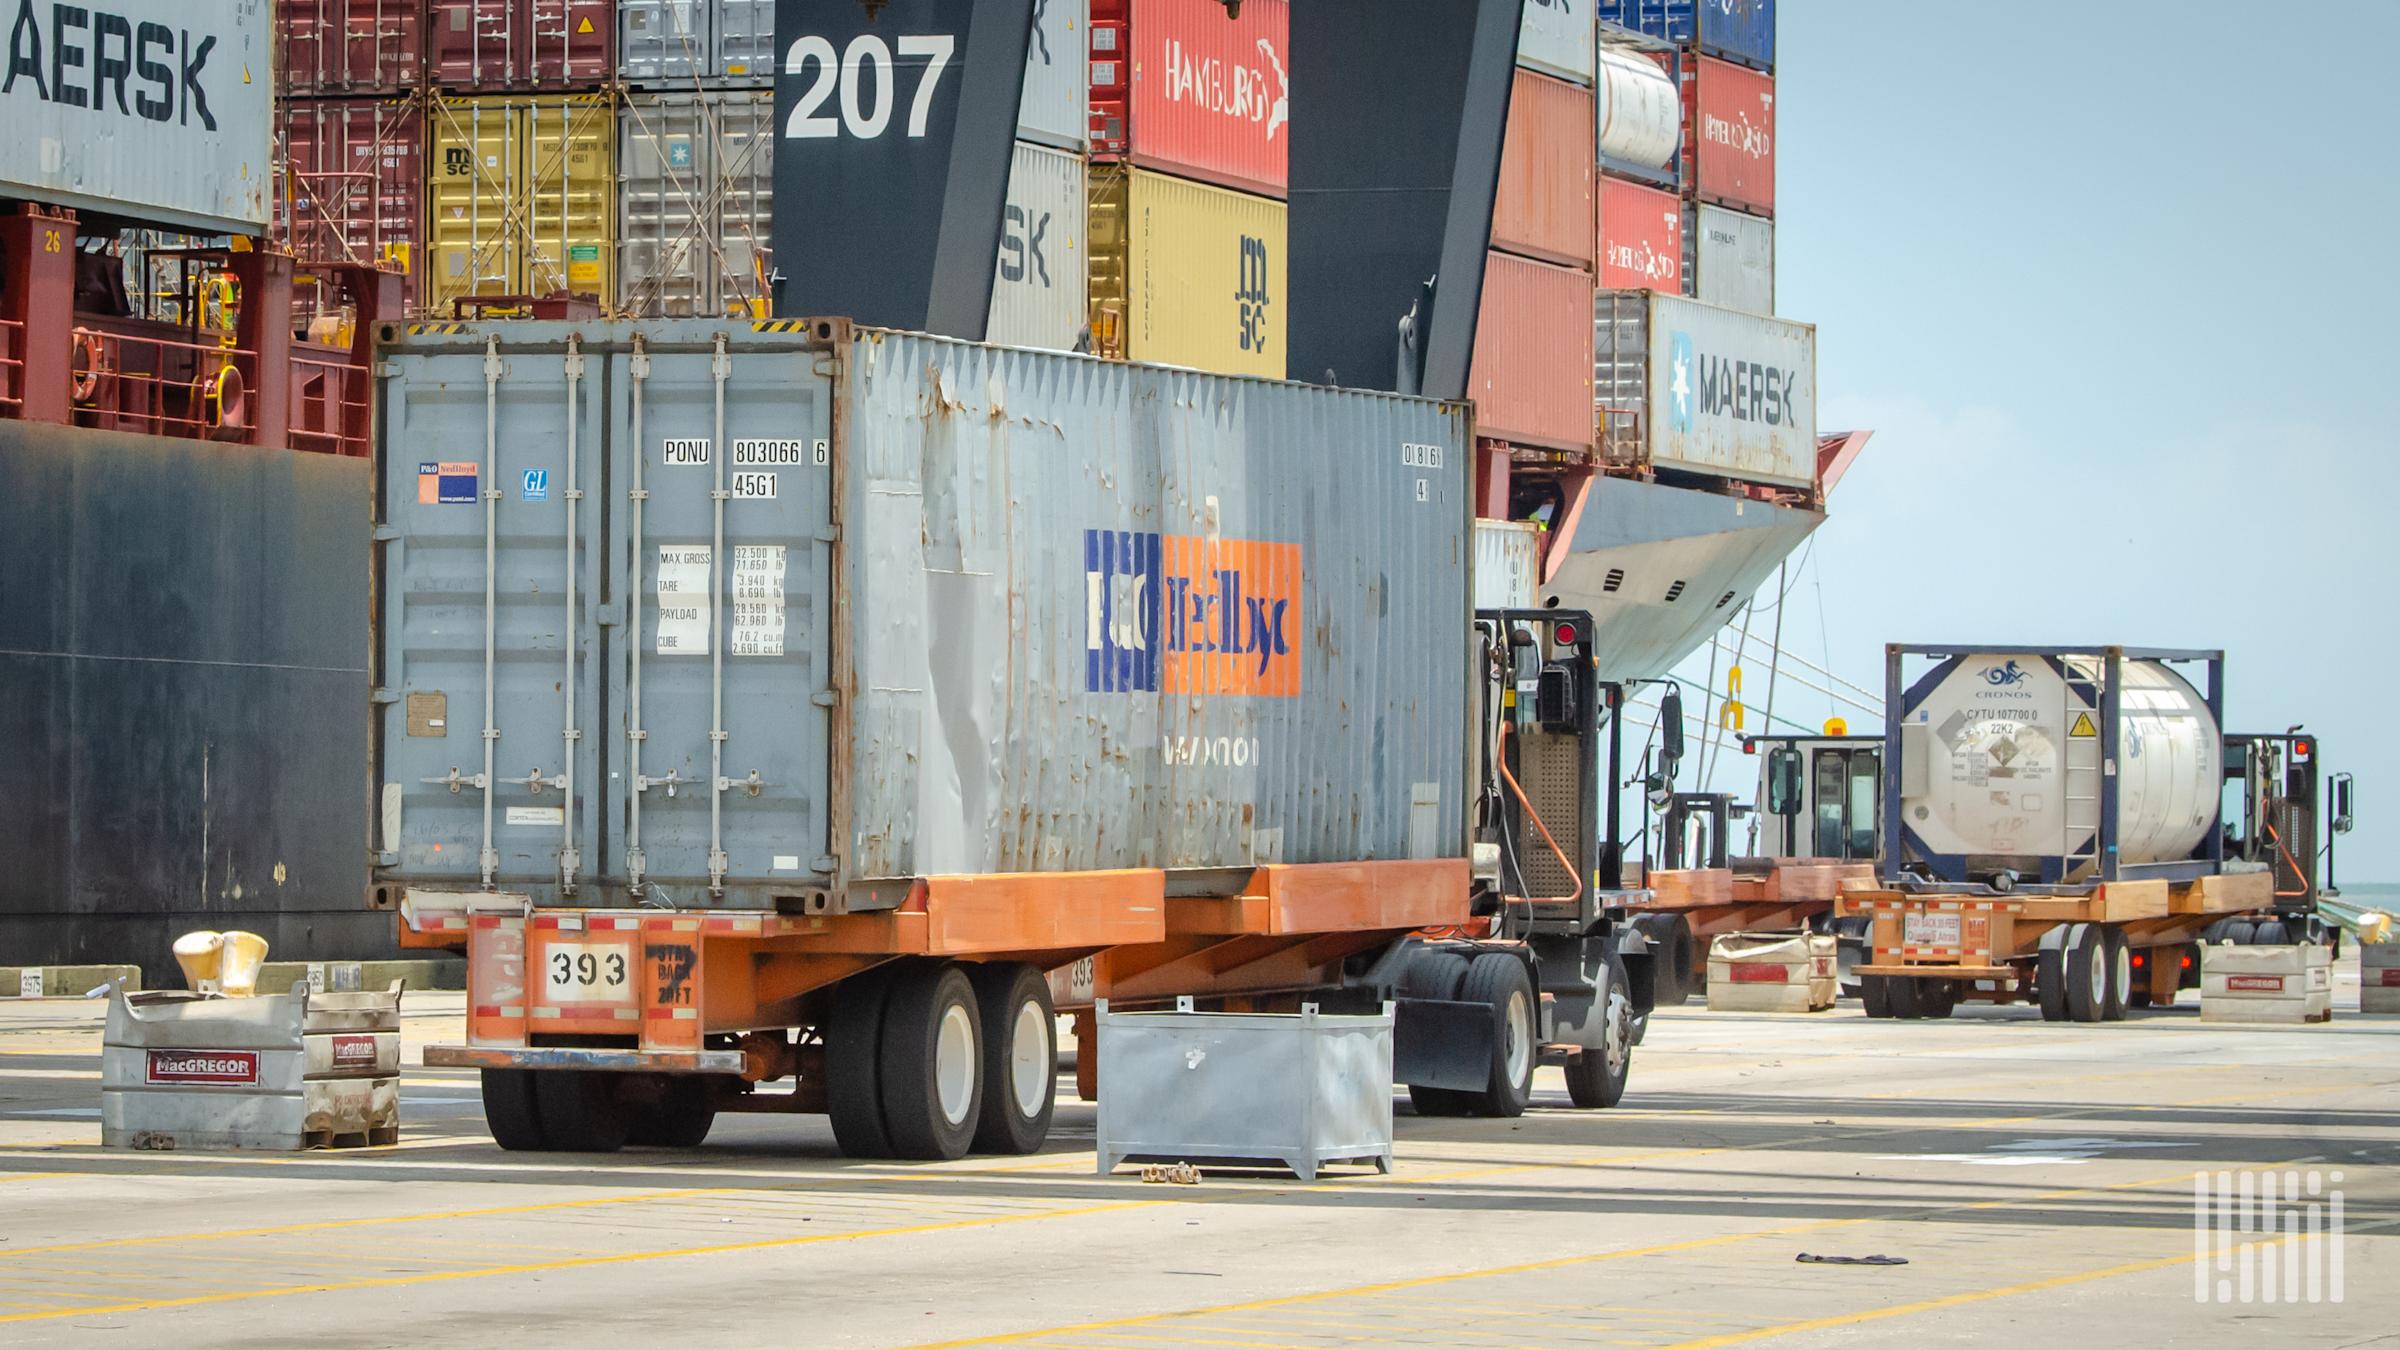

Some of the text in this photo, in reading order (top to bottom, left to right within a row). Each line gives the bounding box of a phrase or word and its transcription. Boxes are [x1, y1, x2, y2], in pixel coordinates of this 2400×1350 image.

[785, 34, 955, 139] 207
[45, 230, 60, 253] 26
[1700, 353, 1795, 428] MAERSK
[665, 441, 825, 463] PONU 803066 6
[420, 464, 438, 473] P&O
[524, 470, 547, 492] GL
[735, 474, 776, 496] 45G1
[684, 553, 711, 565] GROSS
[735, 547, 786, 561] 32.500 kg
[735, 560, 783, 570] 71.650 lb
[658, 580, 678, 592] TARE
[739, 575, 784, 589] 3.940 kg
[739, 587, 781, 598] 8.690 lb
[660, 608, 698, 620] PAYLOAD
[735, 603, 767, 614] 28.560
[735, 615, 783, 626] 62.960 lb
[657, 636, 678, 647] CUBE
[739, 631, 758, 642] 76.2
[733, 643, 758, 654] 2.690
[1975, 691, 2033, 699] CRONOS
[1997, 709, 2029, 720] 107700
[2031, 709, 2038, 721] 0
[1991, 723, 2014, 734] 22K2
[552, 952, 625, 986] 393
[1072, 957, 1094, 987] 393
[156, 1058, 250, 1074] MacGREGOR
